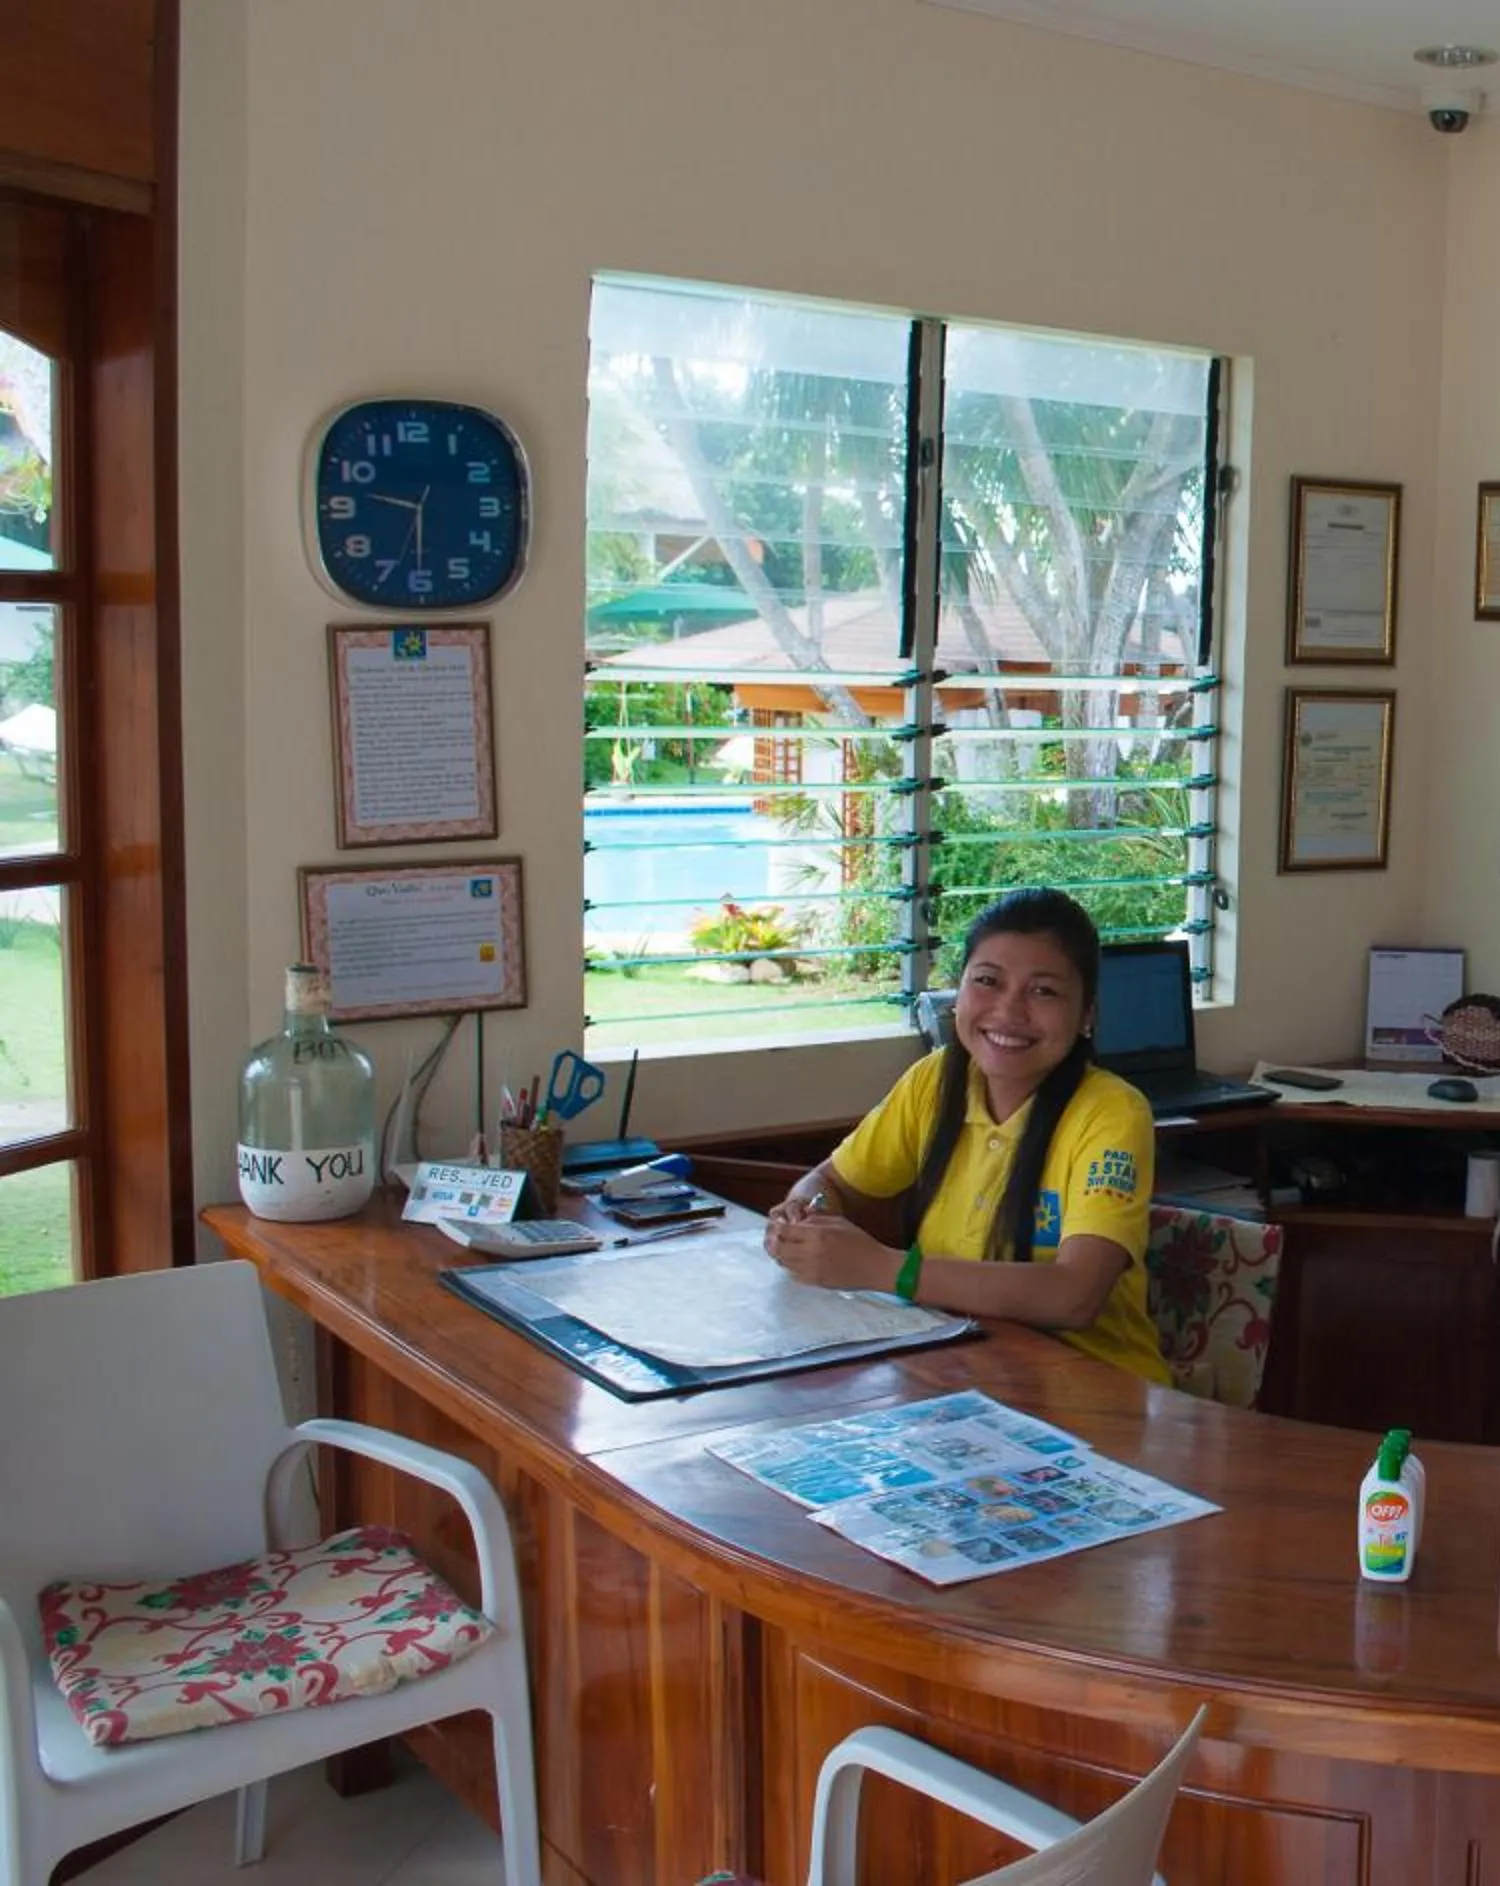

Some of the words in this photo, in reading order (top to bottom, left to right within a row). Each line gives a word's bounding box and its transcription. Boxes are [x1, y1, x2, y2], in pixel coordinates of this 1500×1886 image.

[396, 421, 430, 443] 12
[367, 434, 392, 456] 11
[447, 434, 458, 455] 1
[341, 460, 376, 483] 10
[465, 461, 491, 483] 2
[328, 496, 357, 519] 9
[479, 496, 501, 518] 3
[345, 534, 371, 557] 8
[469, 530, 491, 553] 4
[375, 559, 400, 583] 7
[447, 558, 470, 579] 5
[407, 569, 433, 593] 6
[306, 1149, 363, 1184] YOU
[428, 1166, 513, 1189] RESVED
